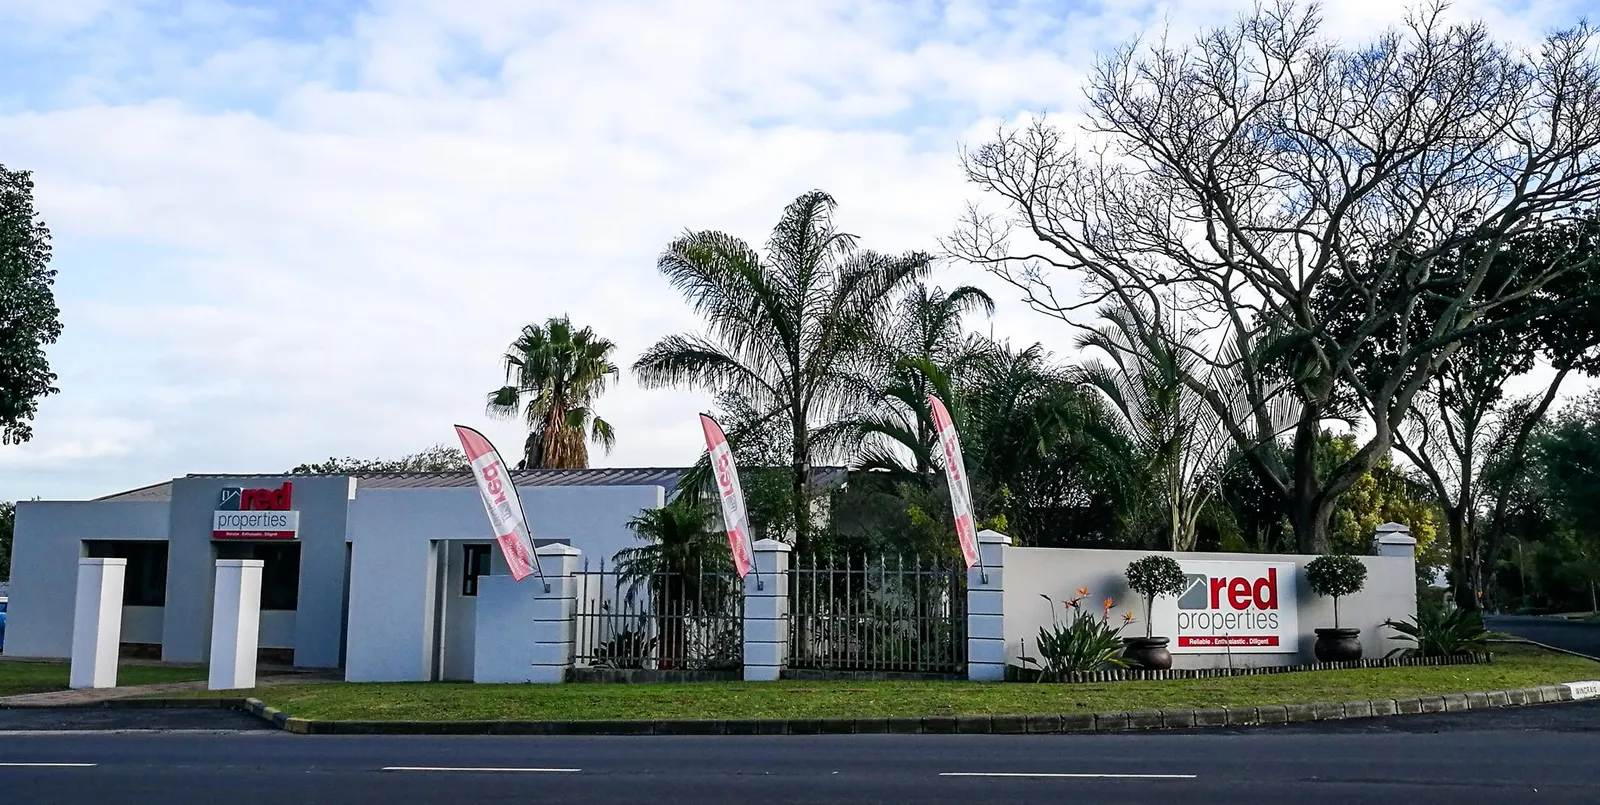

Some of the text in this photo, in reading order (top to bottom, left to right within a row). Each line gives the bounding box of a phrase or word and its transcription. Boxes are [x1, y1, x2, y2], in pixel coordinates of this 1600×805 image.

[241, 481, 292, 511] red
[218, 512, 287, 529] properties
[1210, 567, 1278, 610] red
[1177, 608, 1279, 635] properties
[1249, 638, 1269, 646] Diligent
